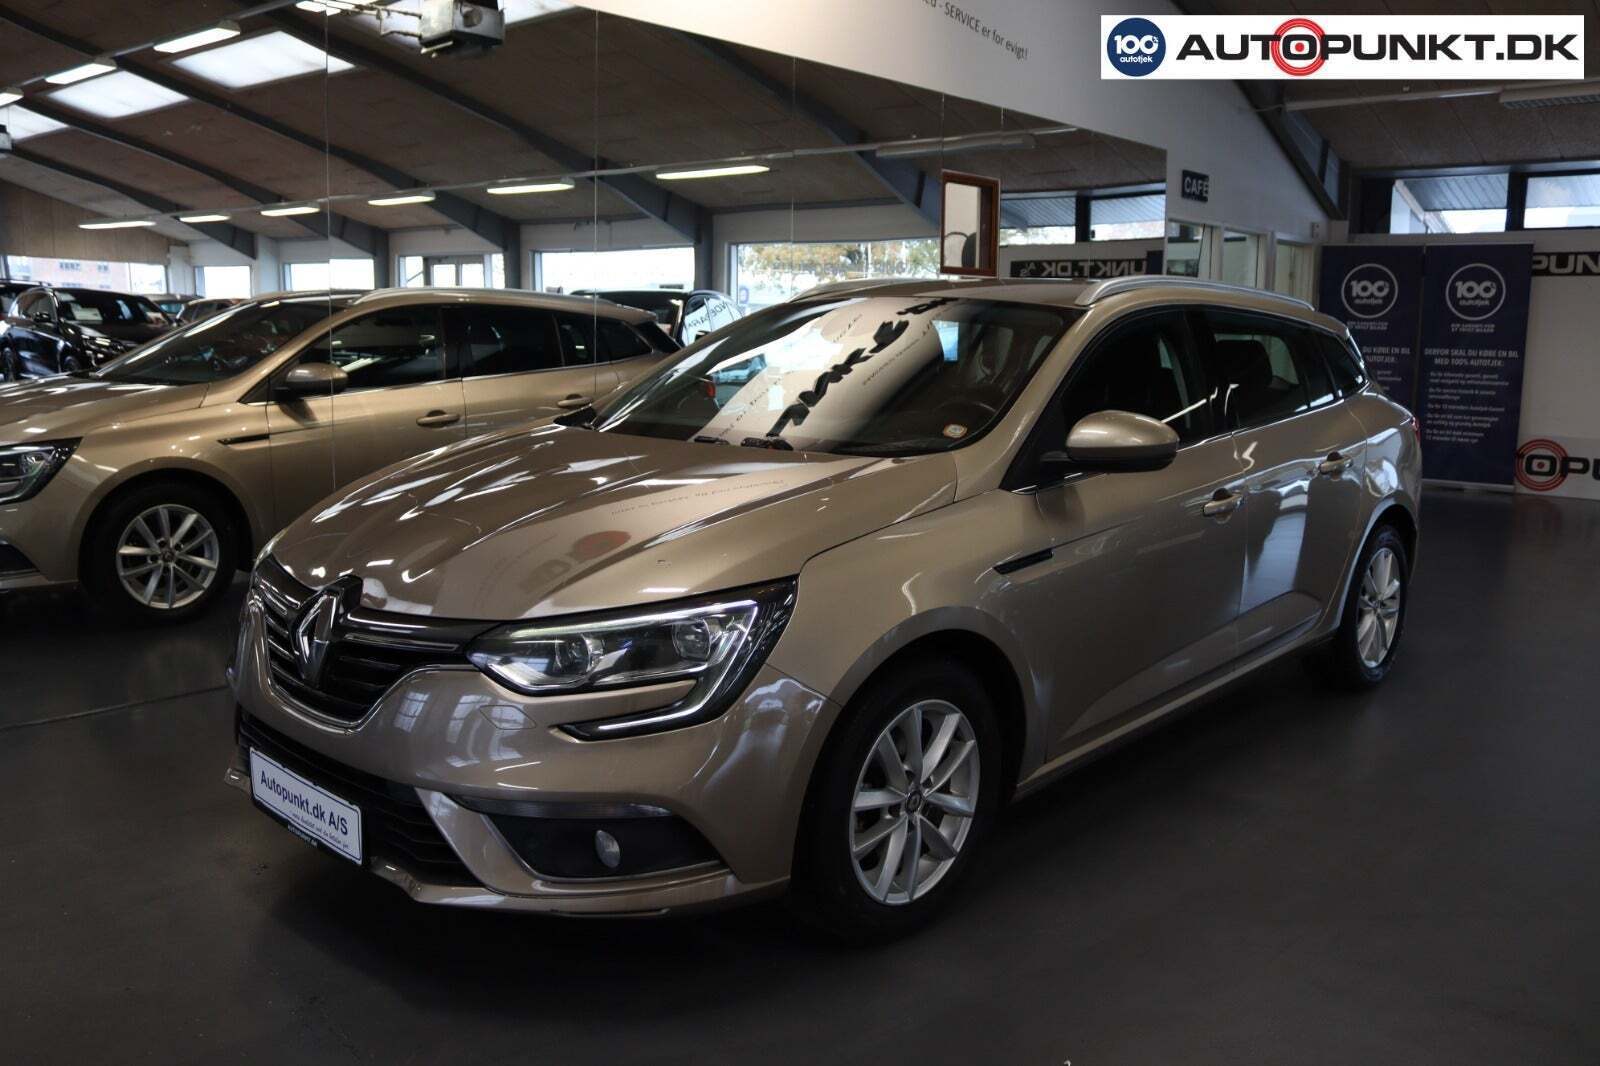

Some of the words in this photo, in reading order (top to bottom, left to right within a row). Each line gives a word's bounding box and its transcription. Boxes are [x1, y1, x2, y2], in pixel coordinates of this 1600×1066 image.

[944, 2, 981, 33] SERVICE
[981, 25, 991, 37] er
[992, 29, 1005, 46] for
[1005, 40, 1029, 61] evigt!
[260, 770, 326, 823] Autopunkt.dk
[328, 810, 348, 836] A/S
